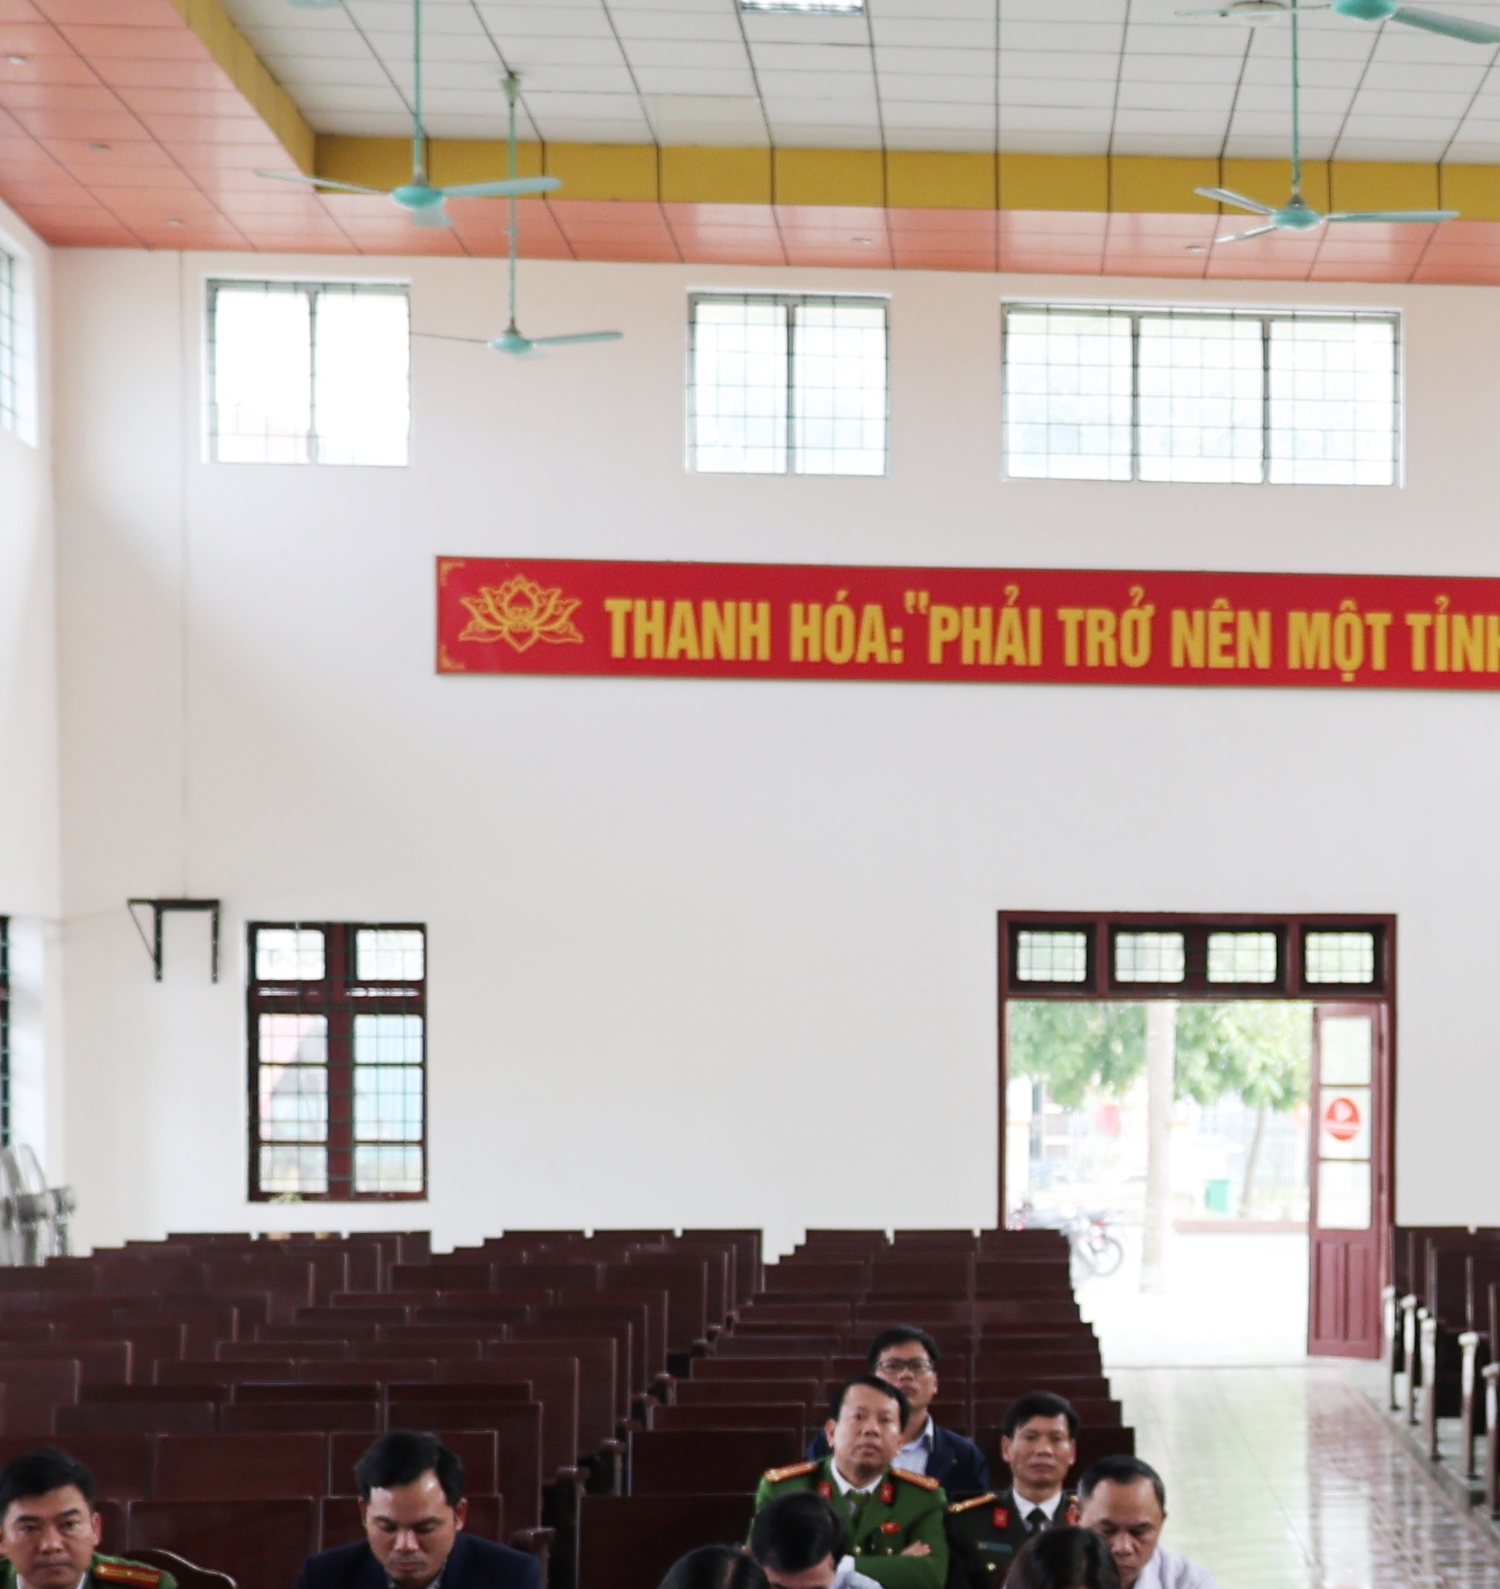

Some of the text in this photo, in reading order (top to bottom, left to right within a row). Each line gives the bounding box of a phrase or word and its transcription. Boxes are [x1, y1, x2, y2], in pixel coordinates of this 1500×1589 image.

[605, 599, 771, 661] THANH
[790, 590, 903, 664] HÓA:
[1058, 585, 1155, 667] TRỞ
[1171, 597, 1271, 669] NÊN
[1287, 599, 1393, 683] MỘT
